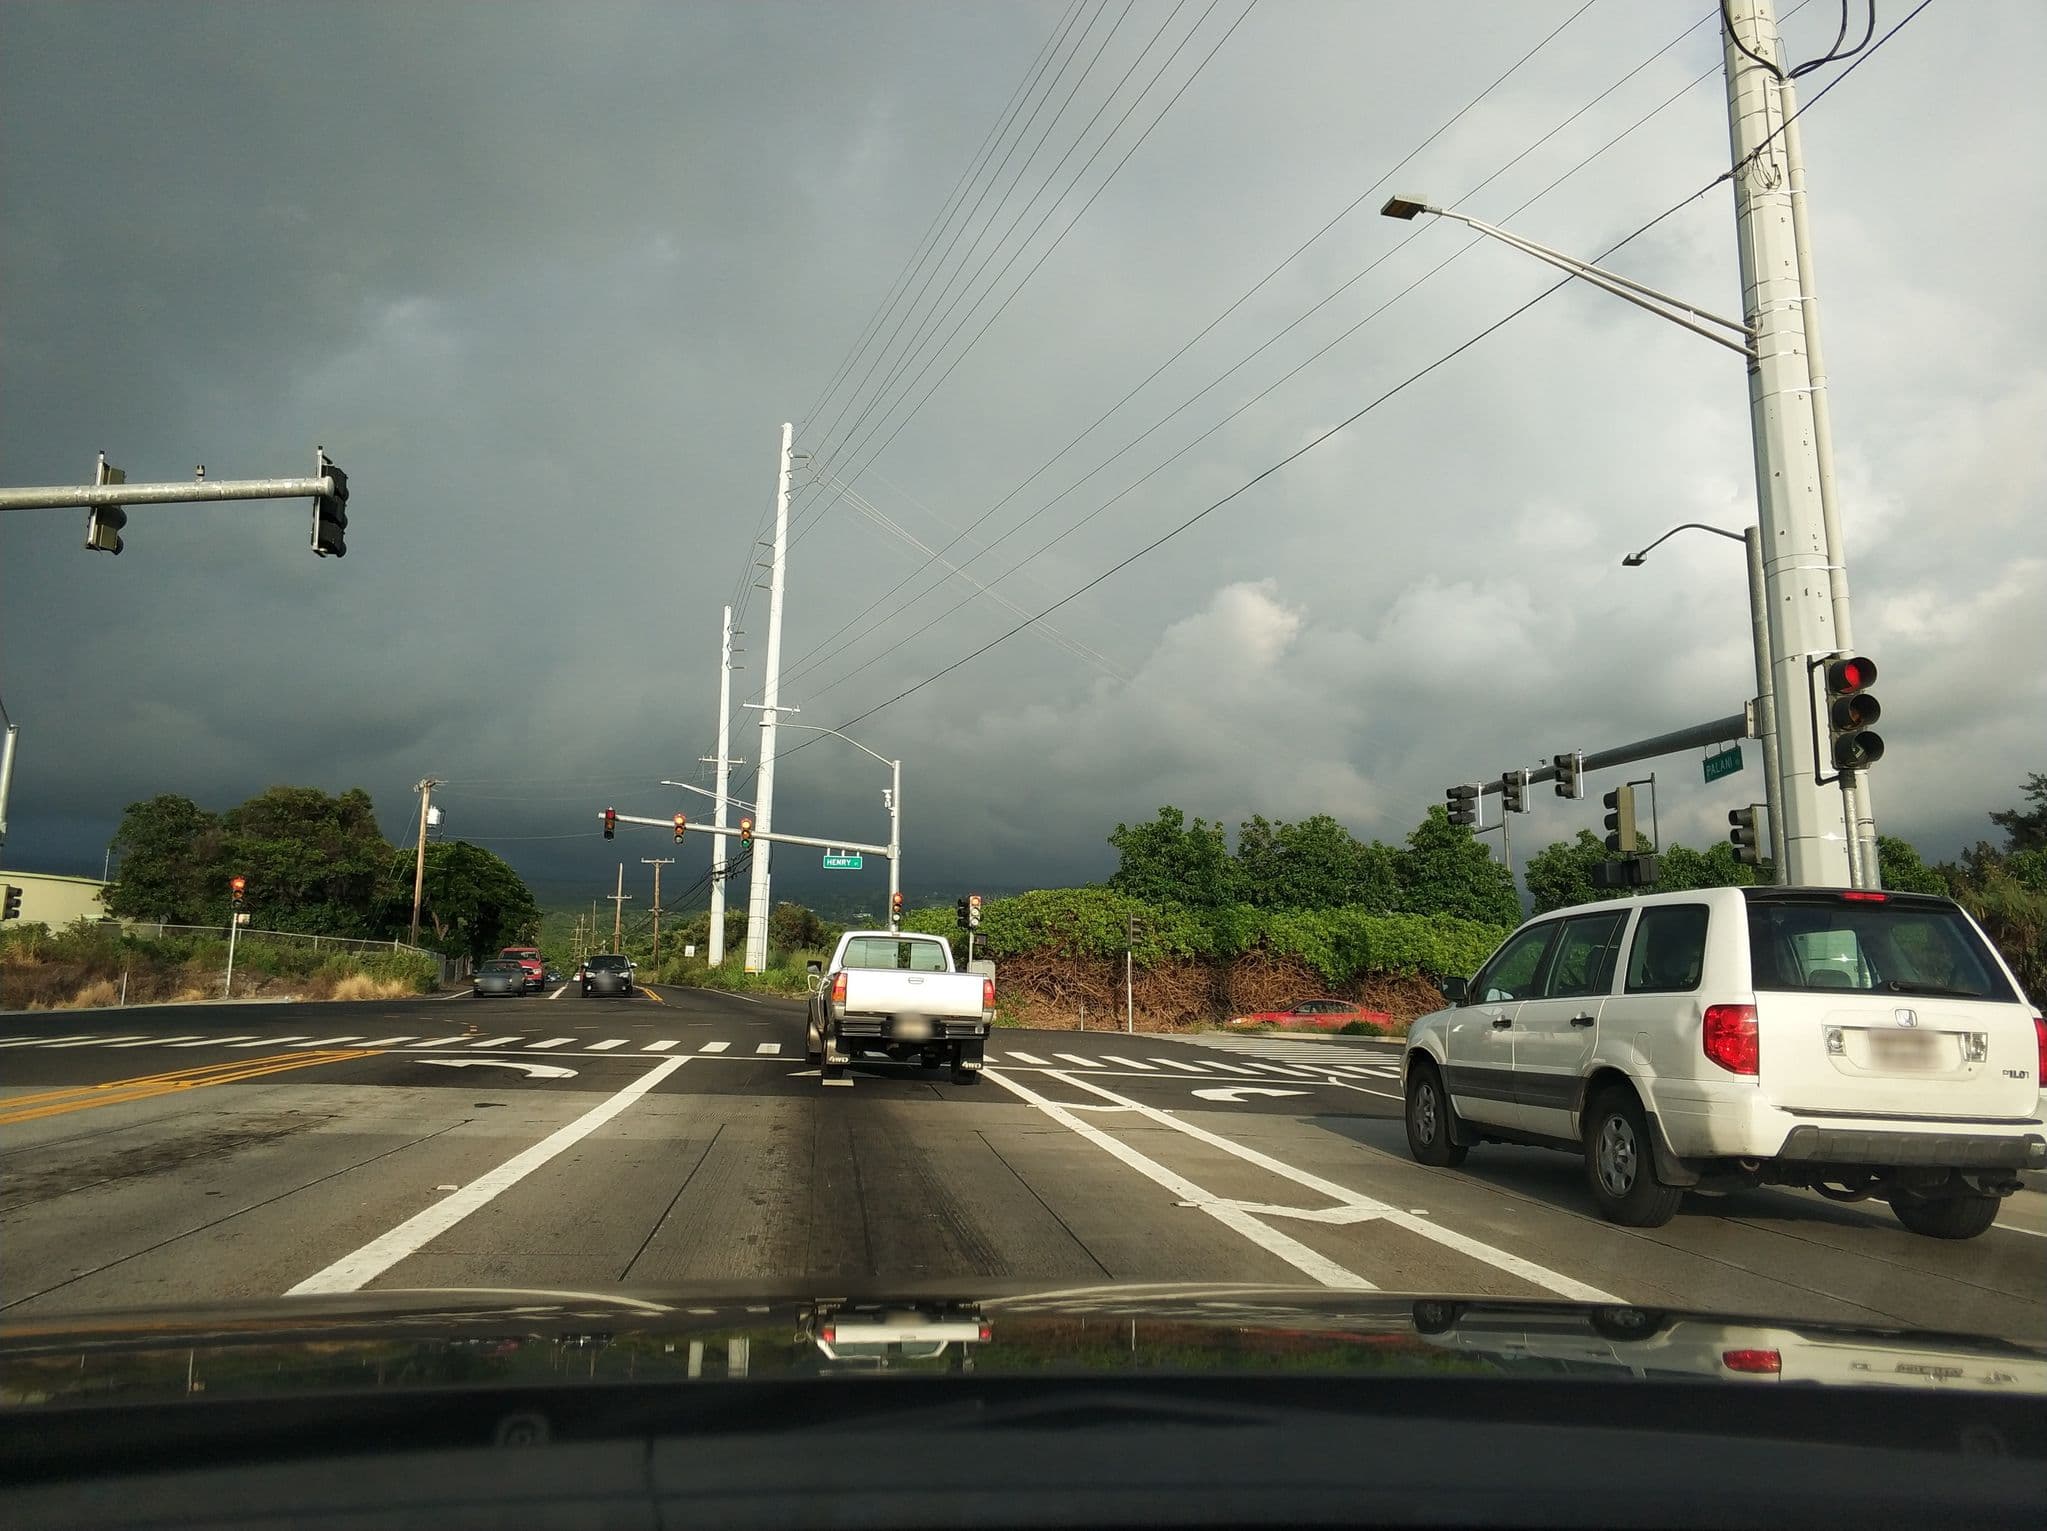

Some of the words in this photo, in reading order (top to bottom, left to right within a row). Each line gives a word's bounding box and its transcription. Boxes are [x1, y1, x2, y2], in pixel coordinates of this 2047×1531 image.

[1706, 754, 1733, 780] PALANI
[961, 1061, 982, 1069] 4WD
[2002, 1069, 2030, 1079] PILOT
